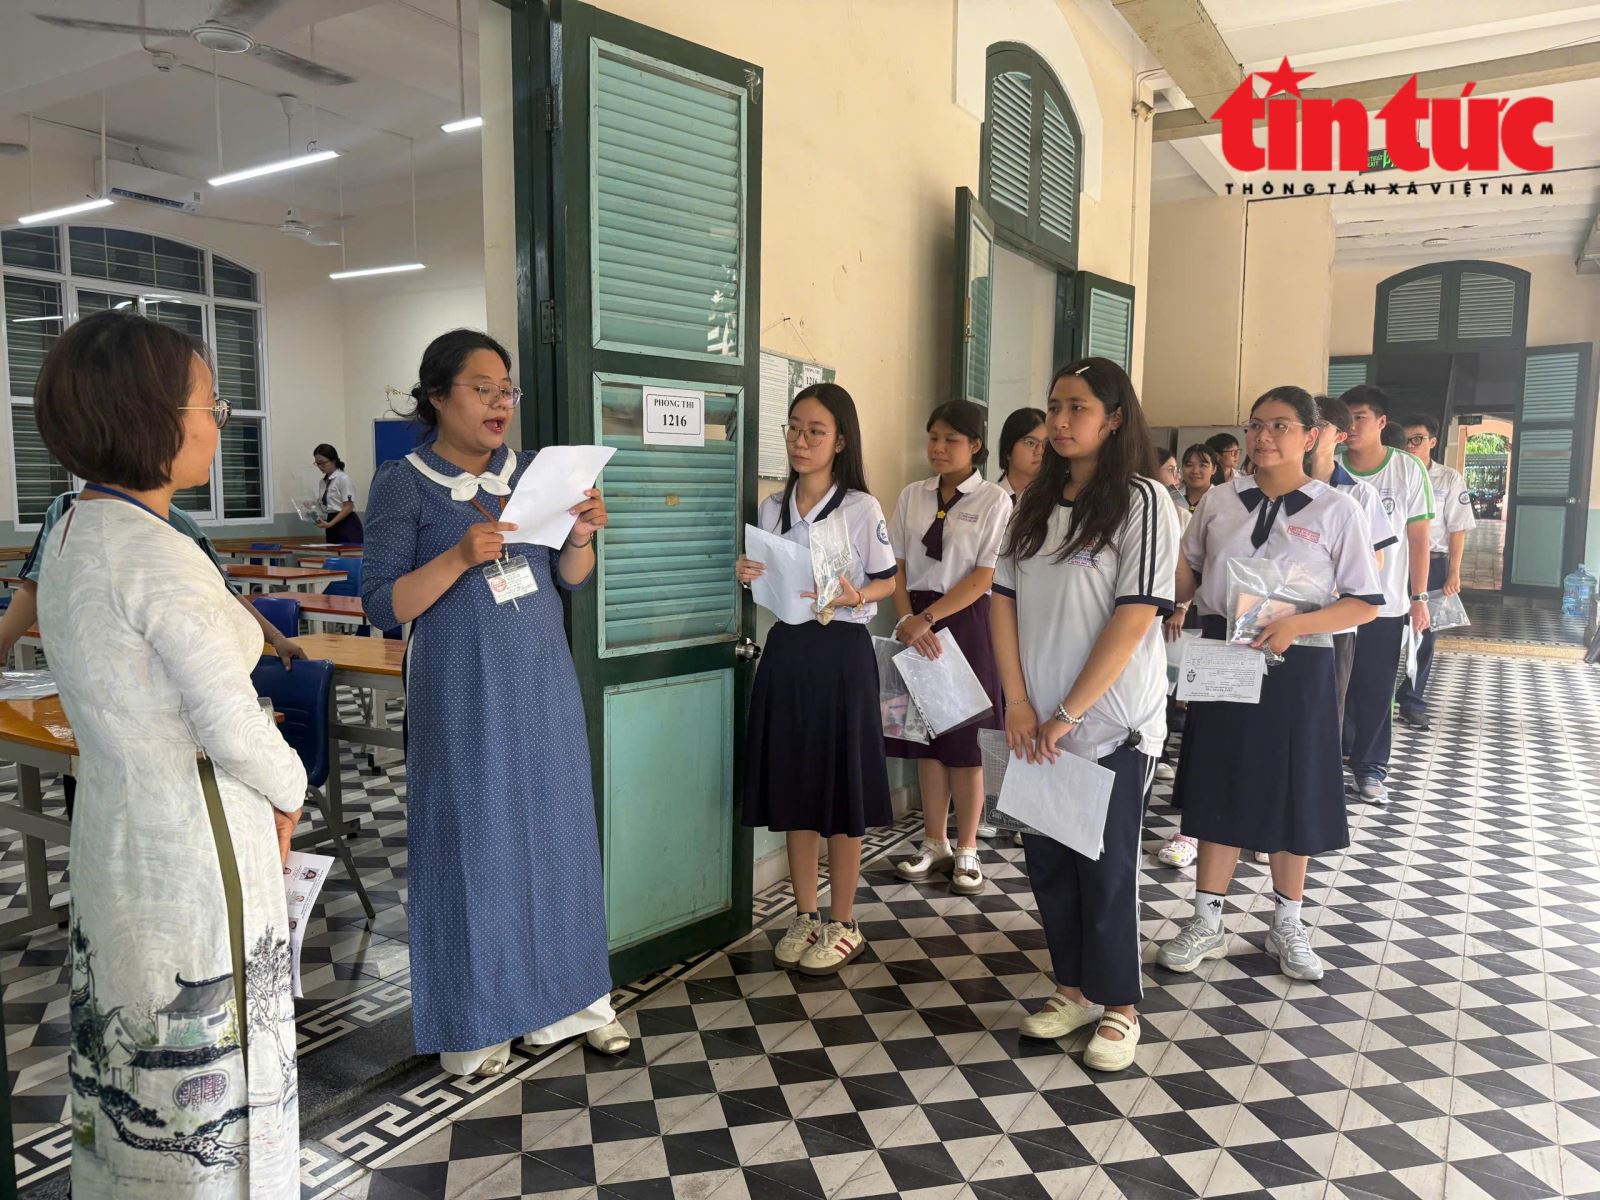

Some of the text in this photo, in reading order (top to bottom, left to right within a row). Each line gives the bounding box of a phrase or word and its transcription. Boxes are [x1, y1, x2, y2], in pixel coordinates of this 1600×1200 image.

[654, 397, 694, 408] PHÒNG THI
[662, 413, 687, 427] 1216
